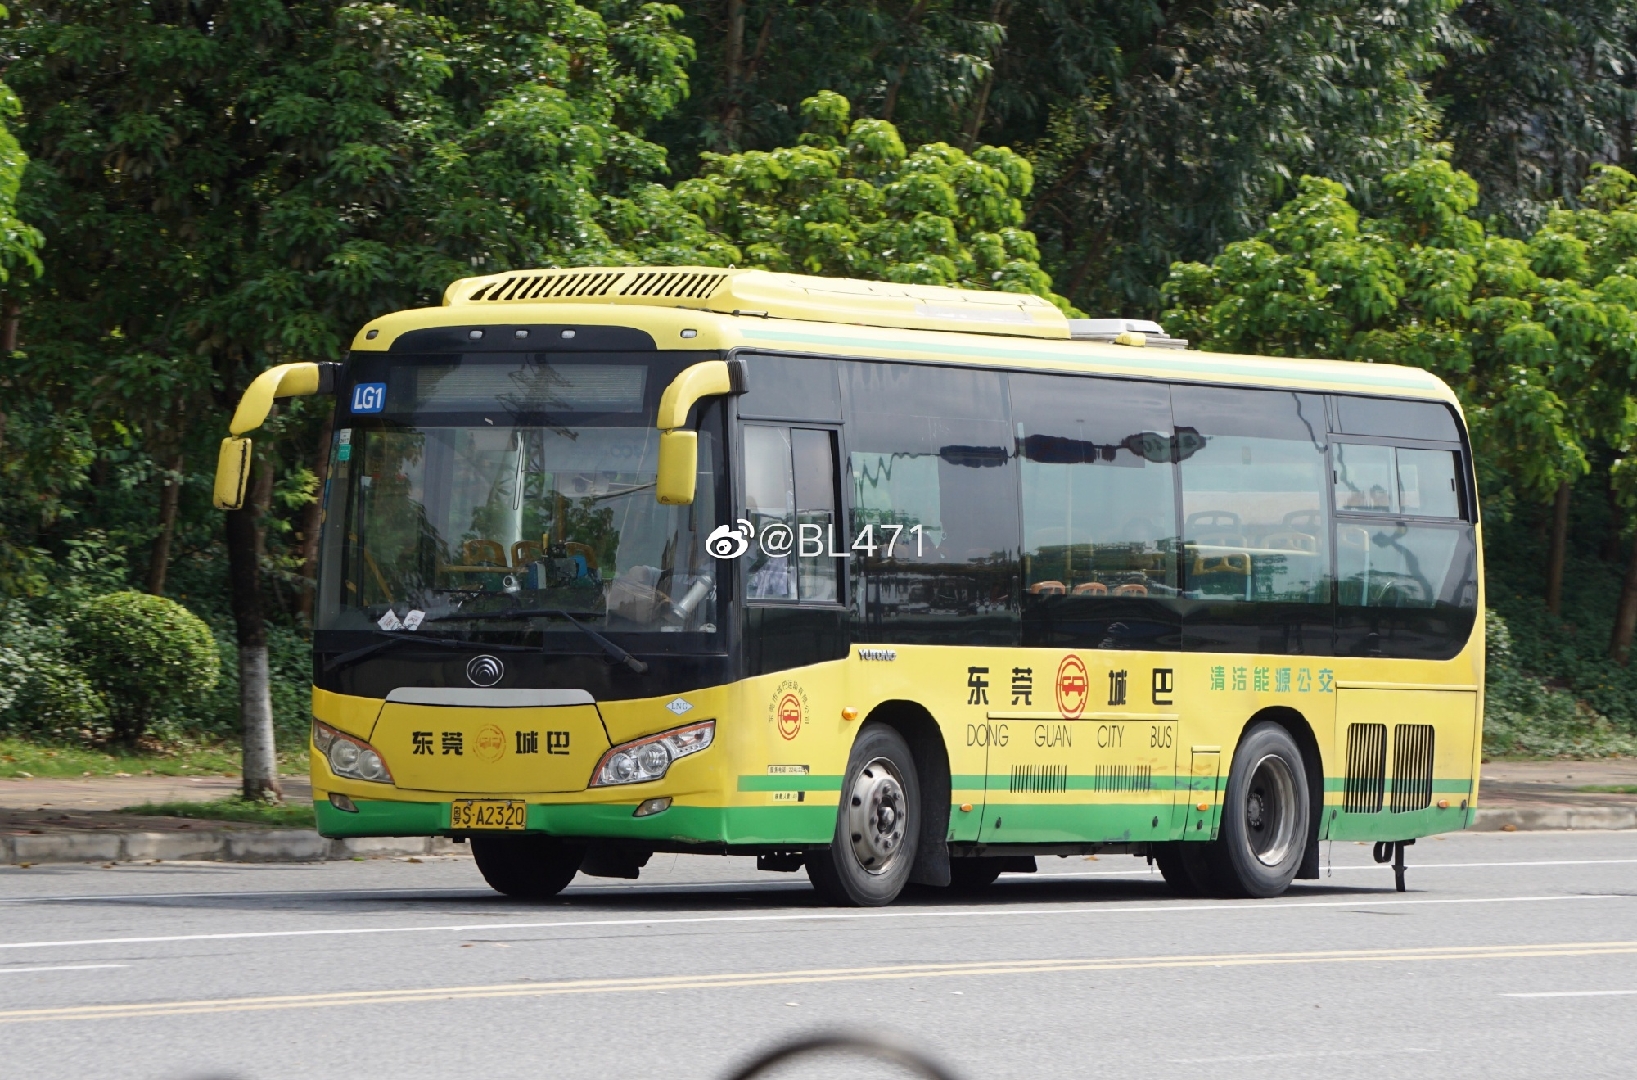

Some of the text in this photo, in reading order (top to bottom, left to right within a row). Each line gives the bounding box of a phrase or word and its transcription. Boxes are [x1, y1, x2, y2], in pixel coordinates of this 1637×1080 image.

[353, 386, 383, 410] LG1
[1210, 666, 1335, 693] 清洁能源公交
[671, 702, 688, 711] LNG
[966, 723, 1173, 749] DONG GUAN CITY BUS
